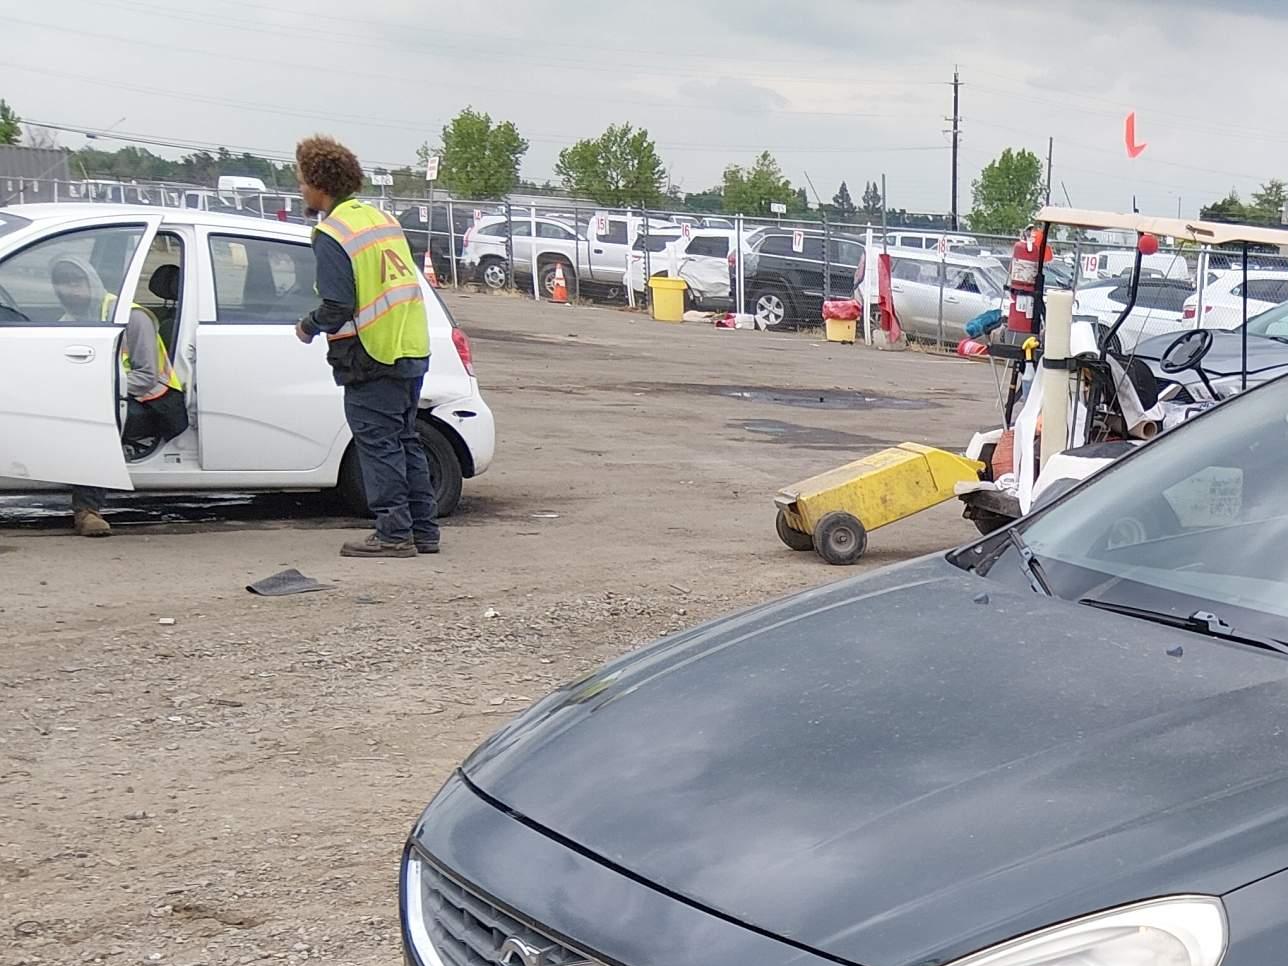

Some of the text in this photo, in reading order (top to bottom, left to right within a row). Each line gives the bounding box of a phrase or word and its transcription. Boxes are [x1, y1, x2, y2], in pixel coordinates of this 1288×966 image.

[597, 216, 605, 231] 15
[682, 223, 691, 238] 16
[794, 232, 802, 248] 17
[1084, 256, 1098, 272] 19
